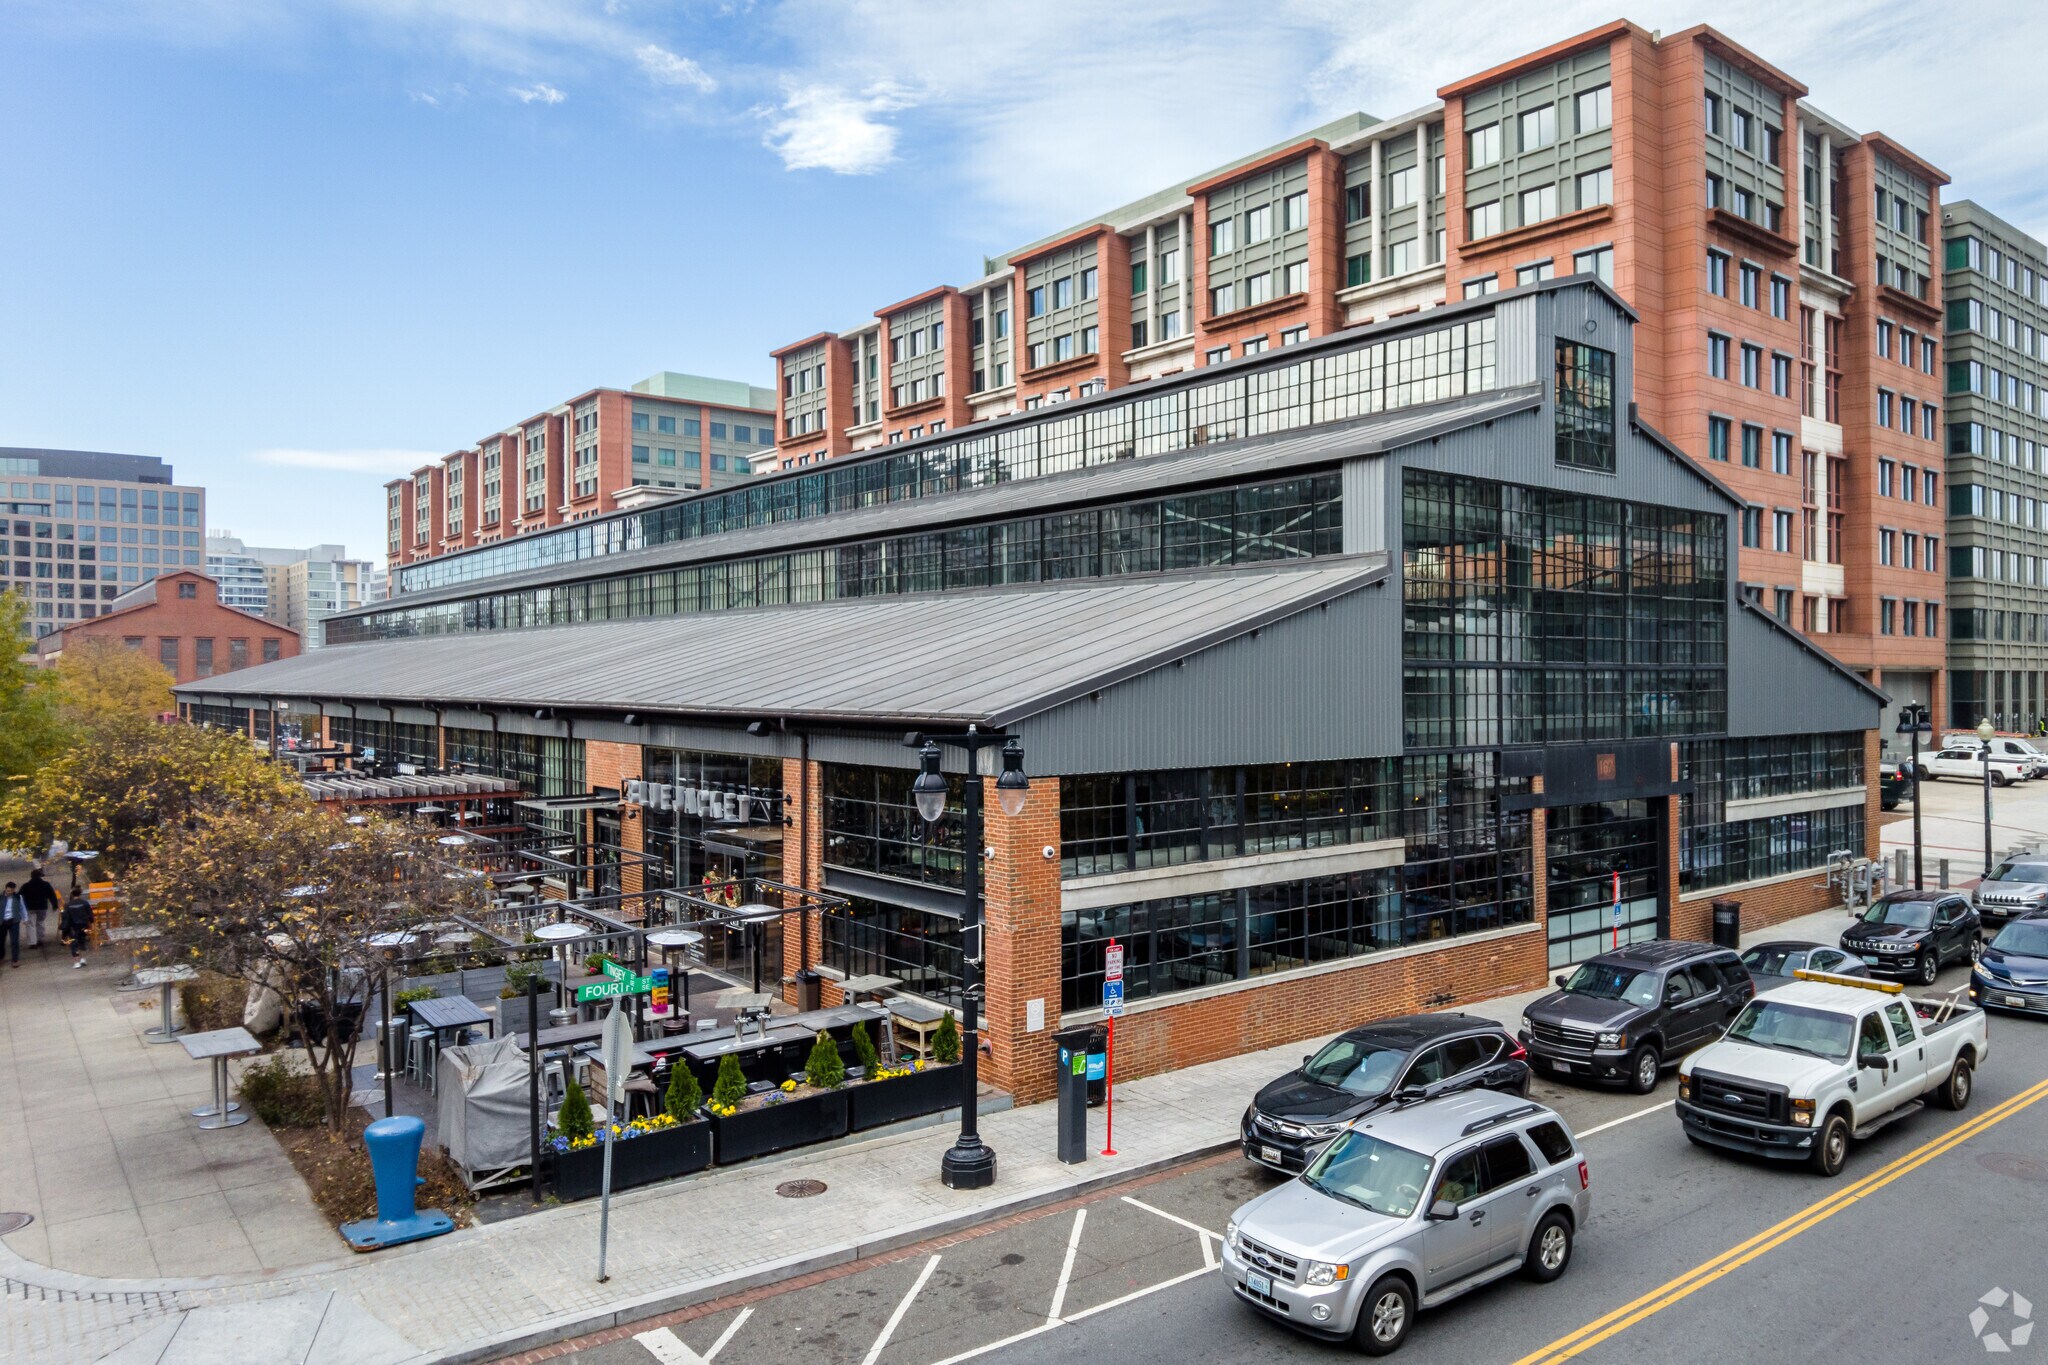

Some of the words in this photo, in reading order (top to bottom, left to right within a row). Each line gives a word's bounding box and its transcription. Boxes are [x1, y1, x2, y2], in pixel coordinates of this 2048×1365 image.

[627, 779, 750, 823] BLUEJACKET
[606, 963, 626, 982] TINGEY
[641, 977, 650, 985] ST
[641, 983, 650, 991] SE
